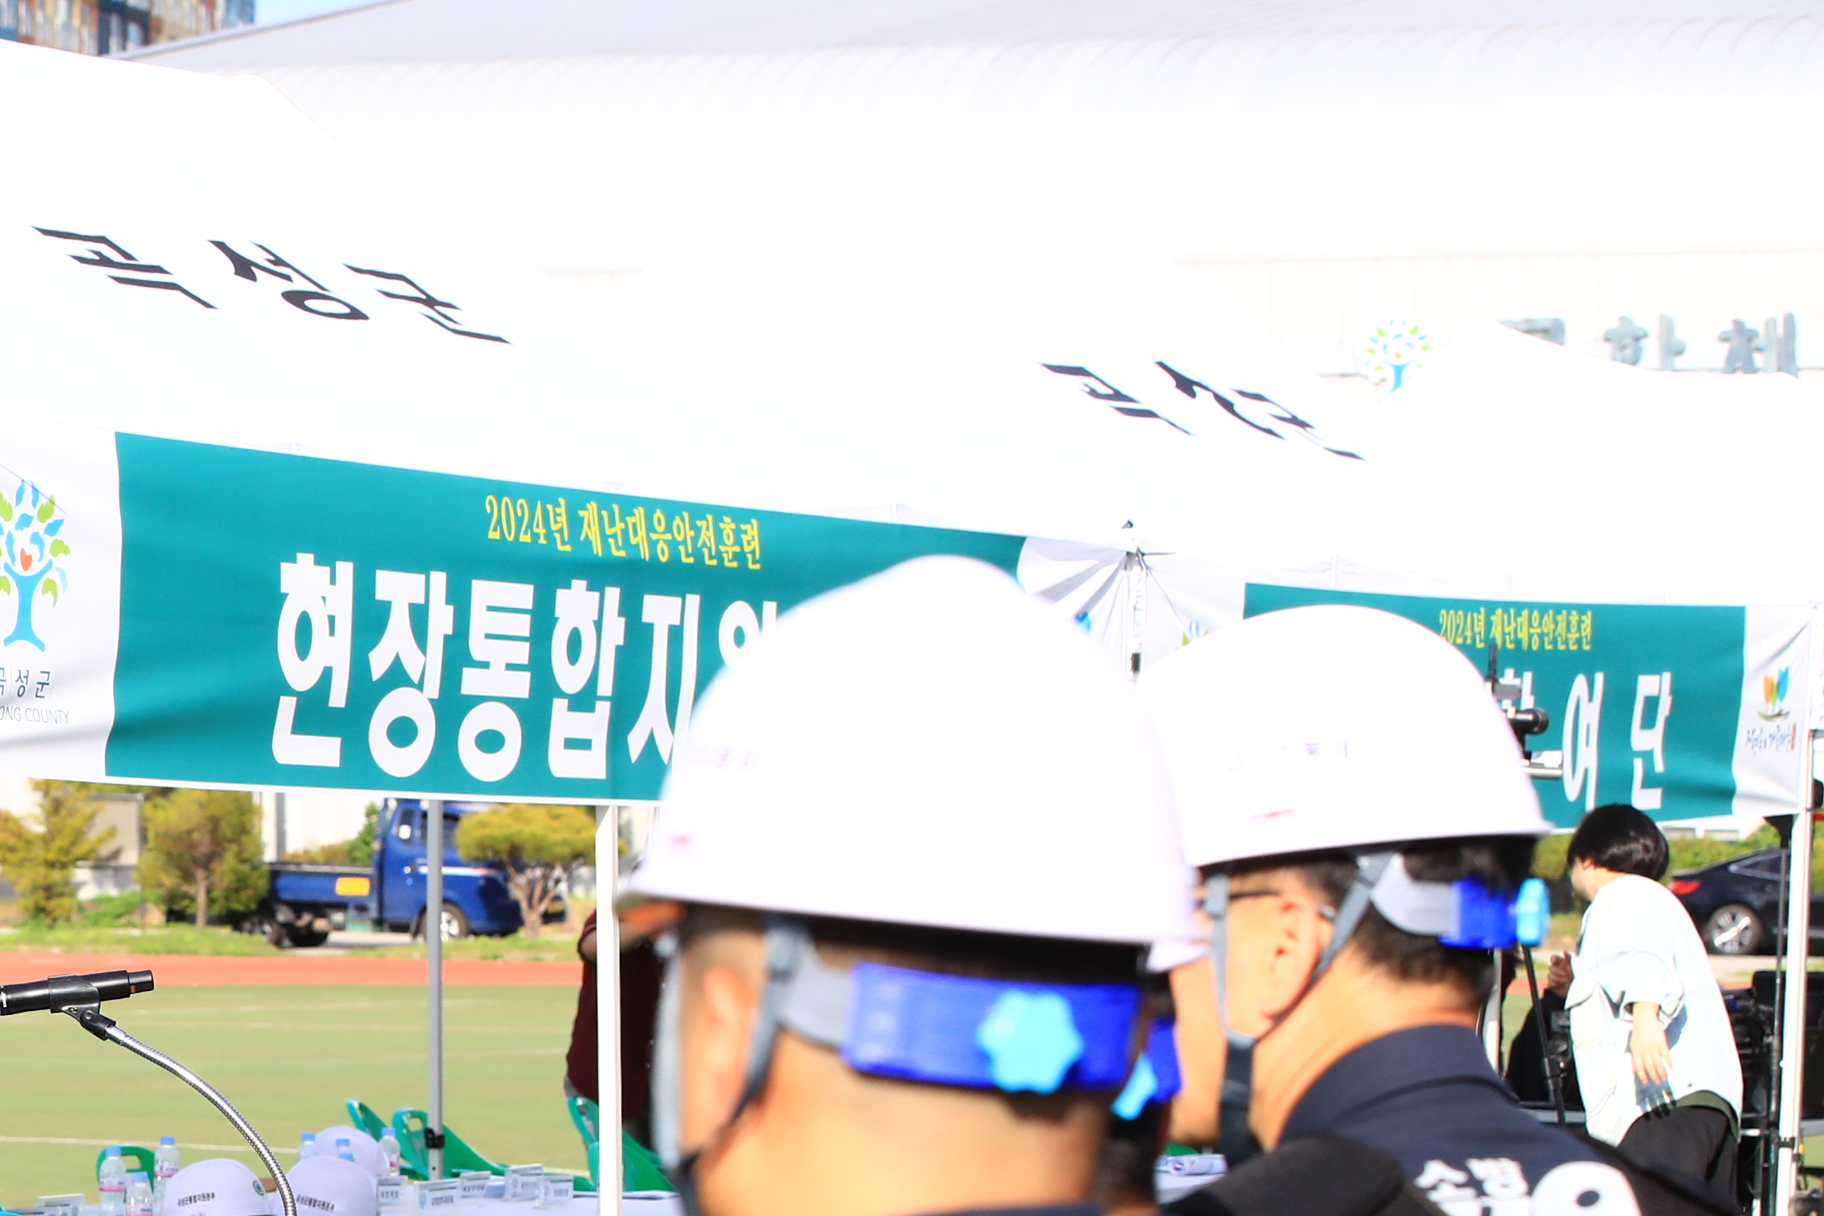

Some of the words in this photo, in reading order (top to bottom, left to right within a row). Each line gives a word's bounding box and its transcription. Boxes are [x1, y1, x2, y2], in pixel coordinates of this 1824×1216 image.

[30, 225, 514, 345] 곡성군
[485, 494, 572, 552] 2024년
[577, 500, 762, 571] 재난대응안전훈련
[1439, 607, 1487, 648] 2024년
[1490, 608, 1593, 651] 재난대응안전훈련
[25, 707, 70, 725] COUNTY
